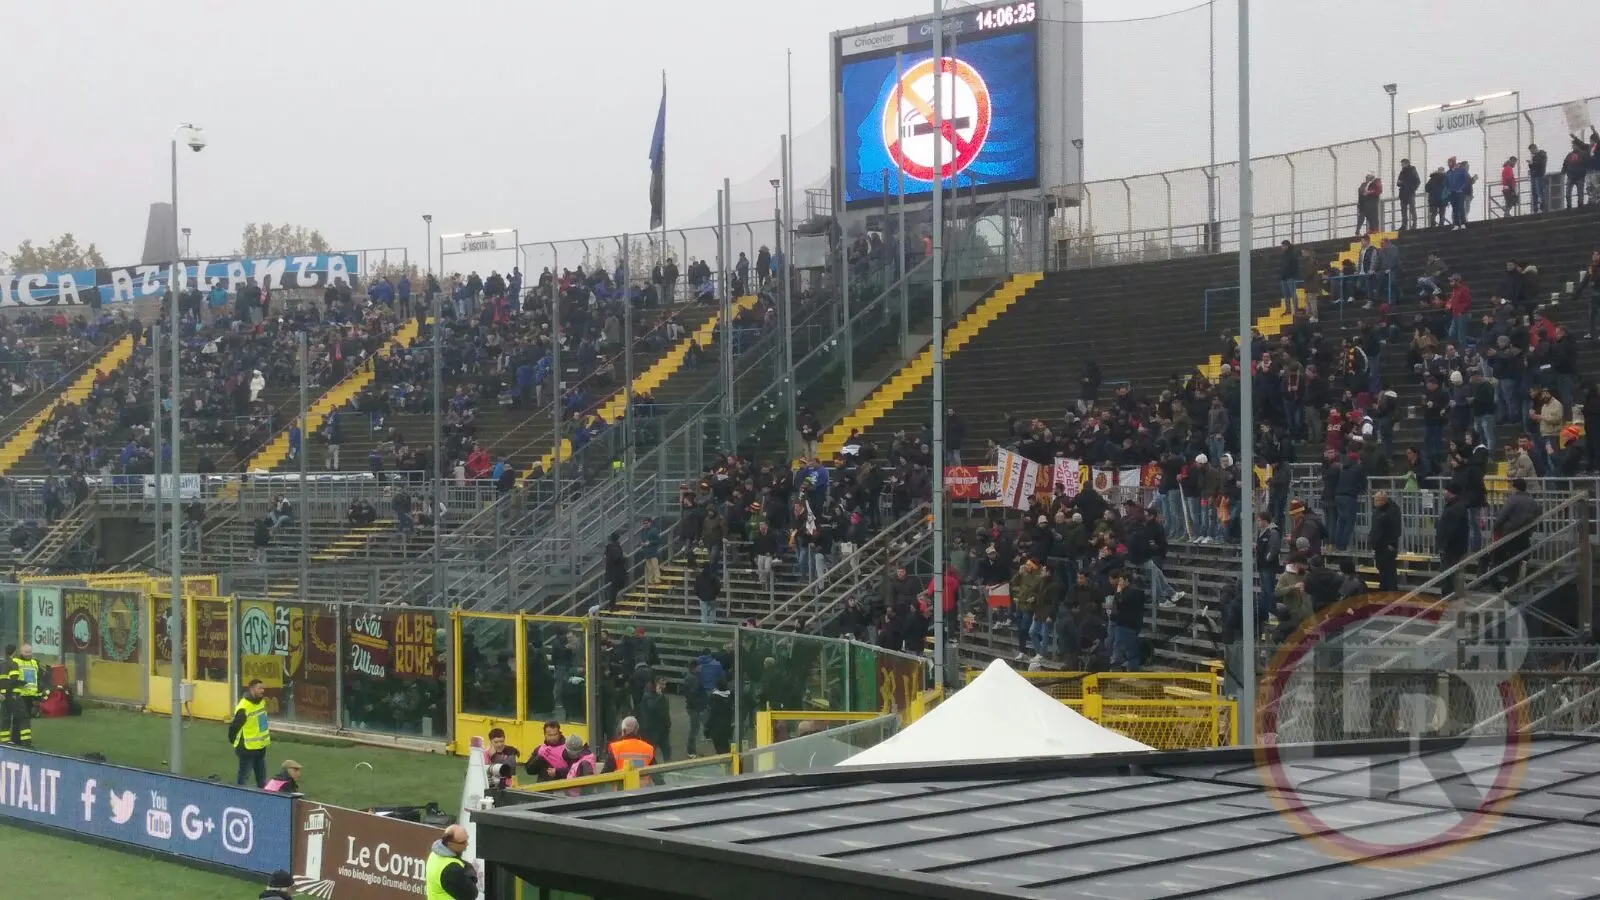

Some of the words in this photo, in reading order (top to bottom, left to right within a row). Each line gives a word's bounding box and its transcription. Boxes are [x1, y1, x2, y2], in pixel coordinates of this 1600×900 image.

[976, 2, 1035, 30] 14:06:25
[1447, 113, 1475, 130] USCITA
[469, 241, 489, 252] USCITA
[38, 595, 54, 617] Via
[34, 625, 60, 647] Gallia
[244, 616, 269, 655] ASR
[355, 612, 382, 638] Noi
[395, 613, 433, 645] ALBE
[351, 643, 385, 678] Ultras
[150, 789, 168, 810] You
[147, 811, 171, 836] Tube
[346, 835, 371, 868] Le
[338, 865, 352, 878] vino
[352, 867, 381, 885] biologico
[382, 875, 412, 892] Grumello
[412, 883, 424, 895] del
